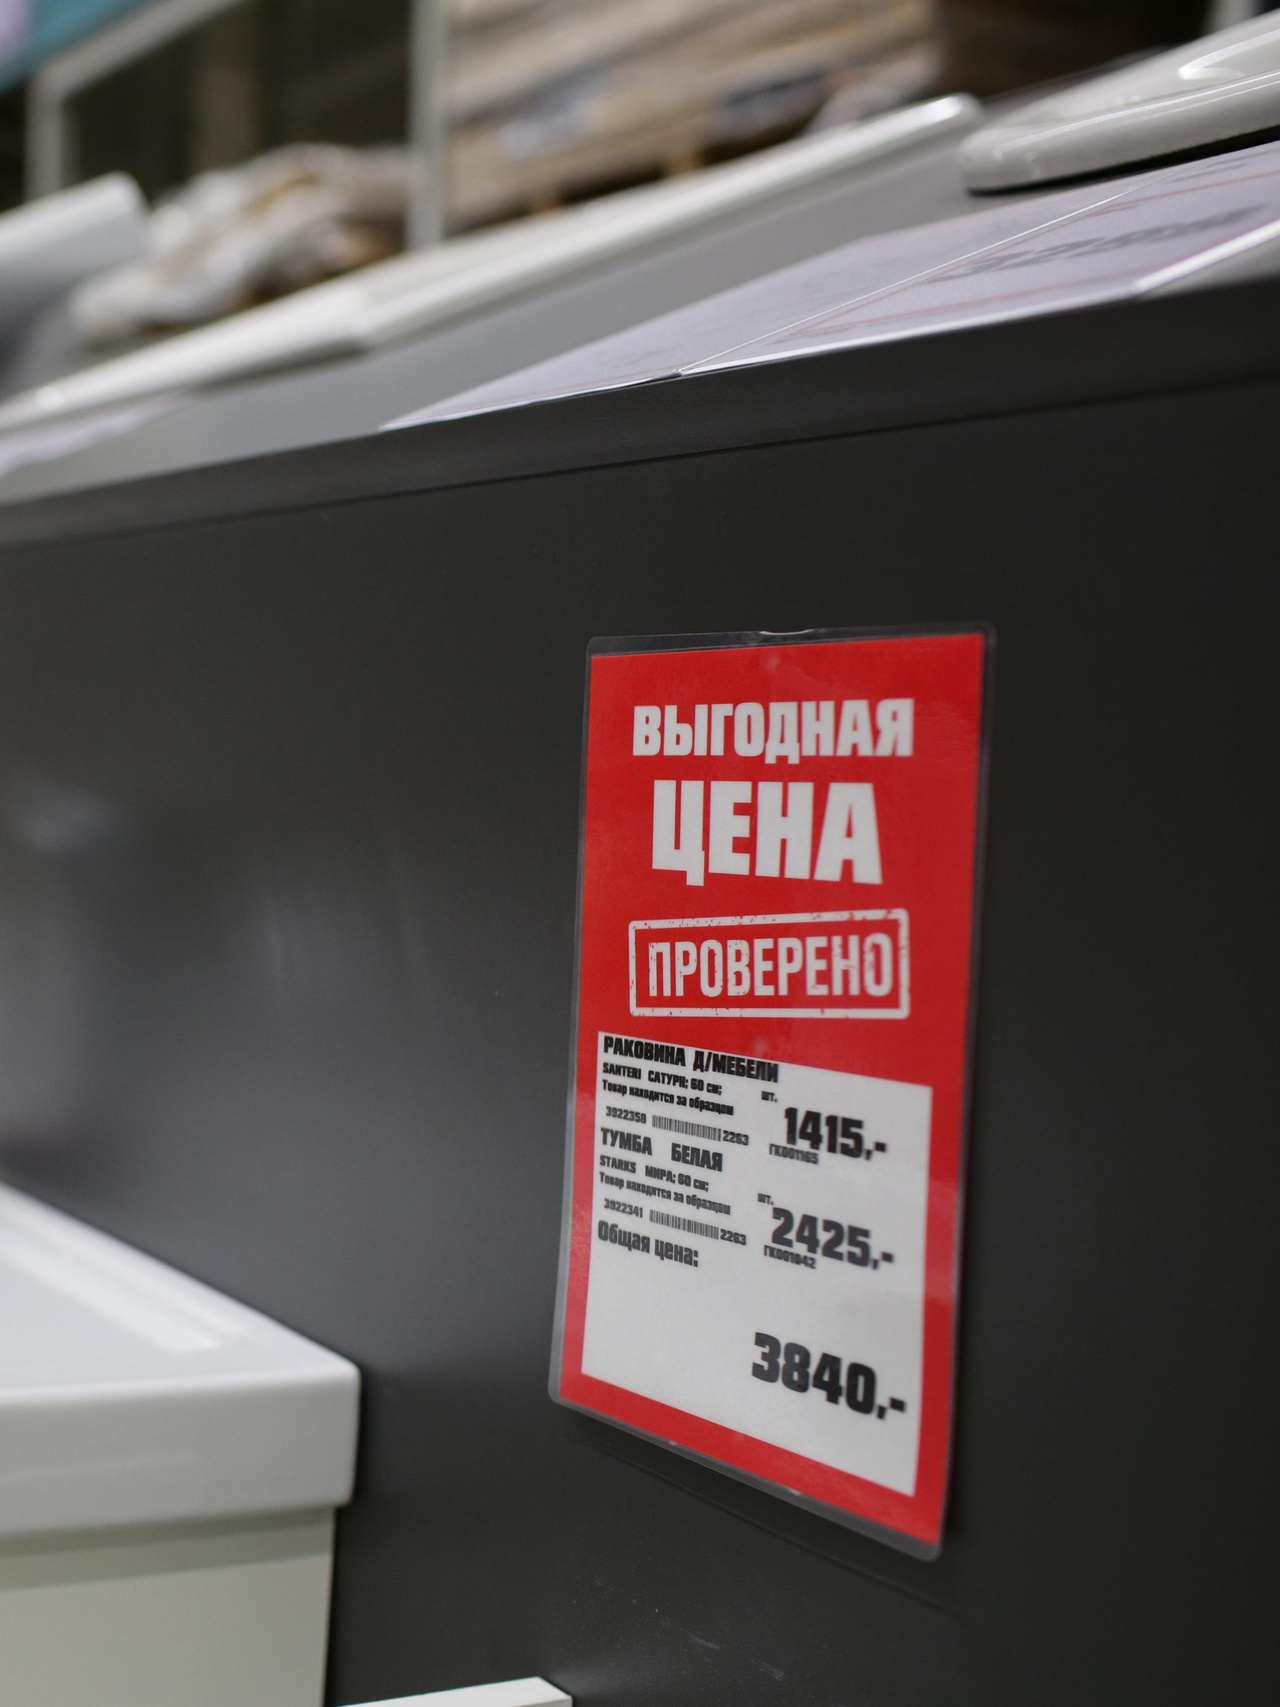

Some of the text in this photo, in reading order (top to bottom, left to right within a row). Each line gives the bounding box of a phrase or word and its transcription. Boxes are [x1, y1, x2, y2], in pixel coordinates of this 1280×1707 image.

[632, 698, 914, 764] ВЫГОДНАЯ
[652, 779, 882, 887] ЦЕНА
[648, 932, 893, 997] ПРОВЕРЕНО
[602, 1062, 642, 1080] SANTERI
[690, 1077, 704, 1092] 60
[603, 1035, 780, 1083] РАКОВИНА Д/МЕБЕЛИ
[602, 1079, 628, 1097] Товар
[629, 1084, 675, 1104] находится
[676, 1095, 687, 1106] за
[601, 1127, 723, 1172] ТУМБА БЕЛАЯ
[606, 1105, 750, 1146] 3922358 2263
[784, 1106, 887, 1161] 1415,-
[599, 1154, 637, 1173] STARKS
[677, 1172, 692, 1187] 60
[599, 1171, 624, 1190] Товар
[626, 1179, 672, 1201] находится
[673, 1191, 684, 1203] за
[597, 1219, 699, 1268] Общая цена:
[720, 1228, 747, 1246] 2263
[771, 1206, 894, 1270] 2425,-
[751, 1331, 907, 1421] 3840,-
